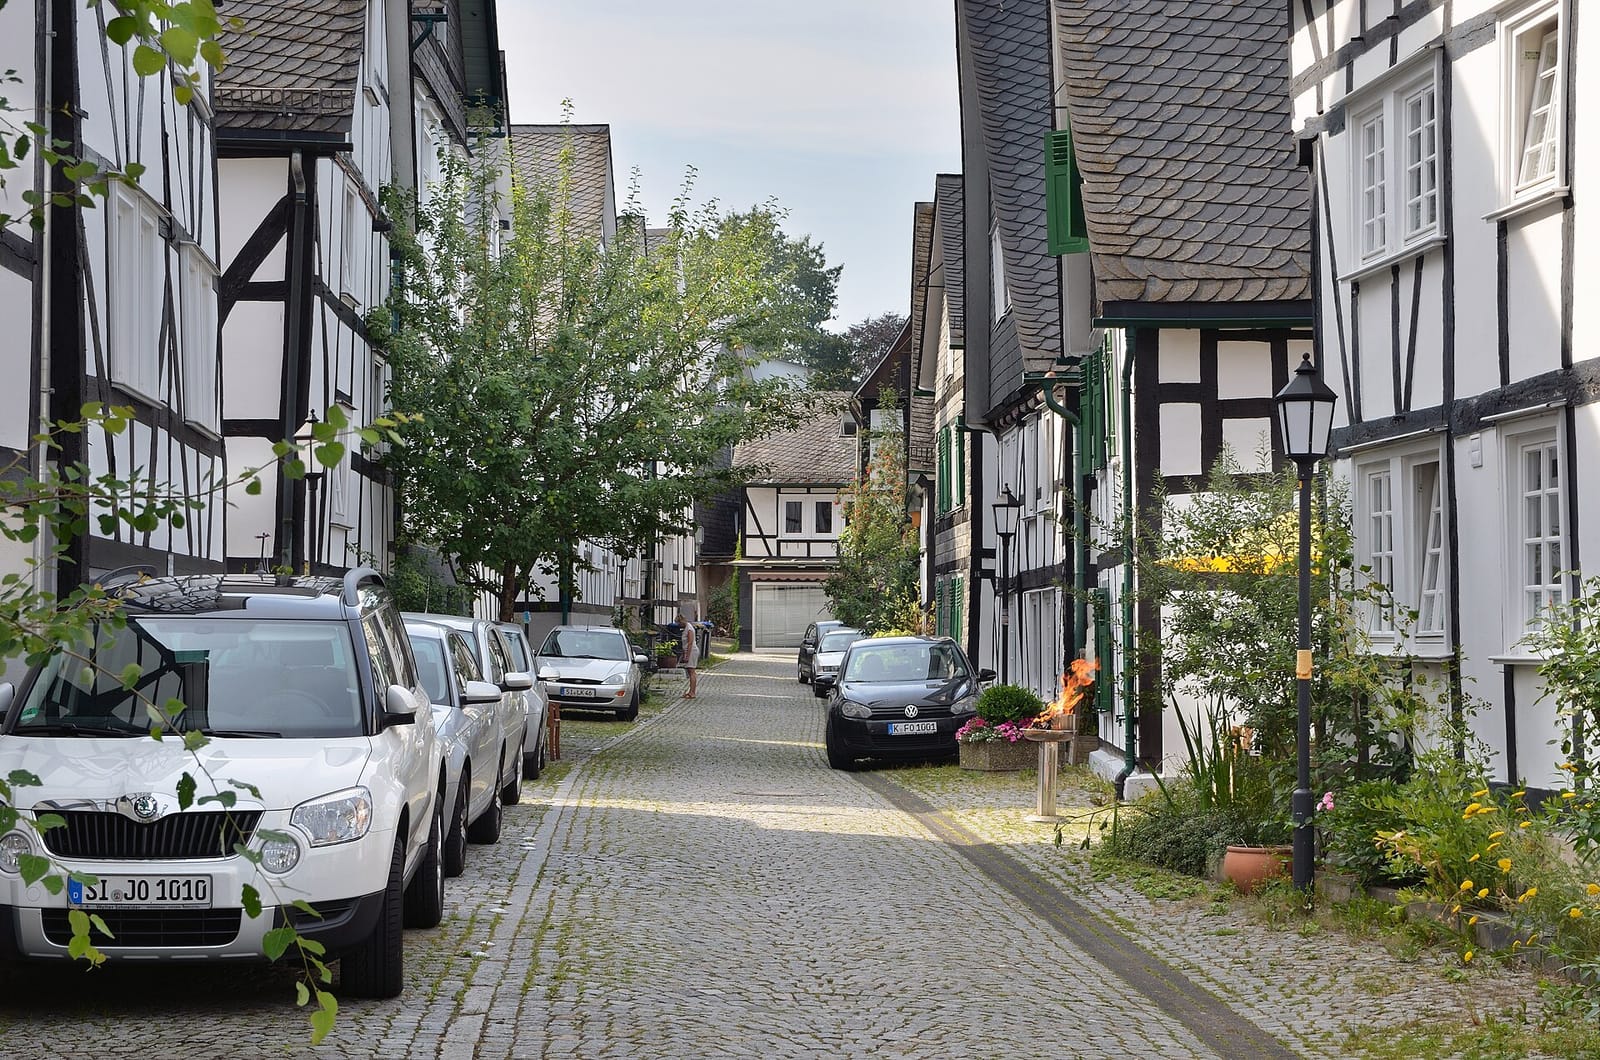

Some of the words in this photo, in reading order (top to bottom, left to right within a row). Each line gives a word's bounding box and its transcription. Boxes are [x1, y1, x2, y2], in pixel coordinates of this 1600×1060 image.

[905, 704, 918, 718] VW
[916, 723, 936, 732] 1001
[86, 879, 109, 901] SI
[124, 879, 149, 901] JO
[156, 879, 207, 901] 1010
[73, 892, 79, 900] D
